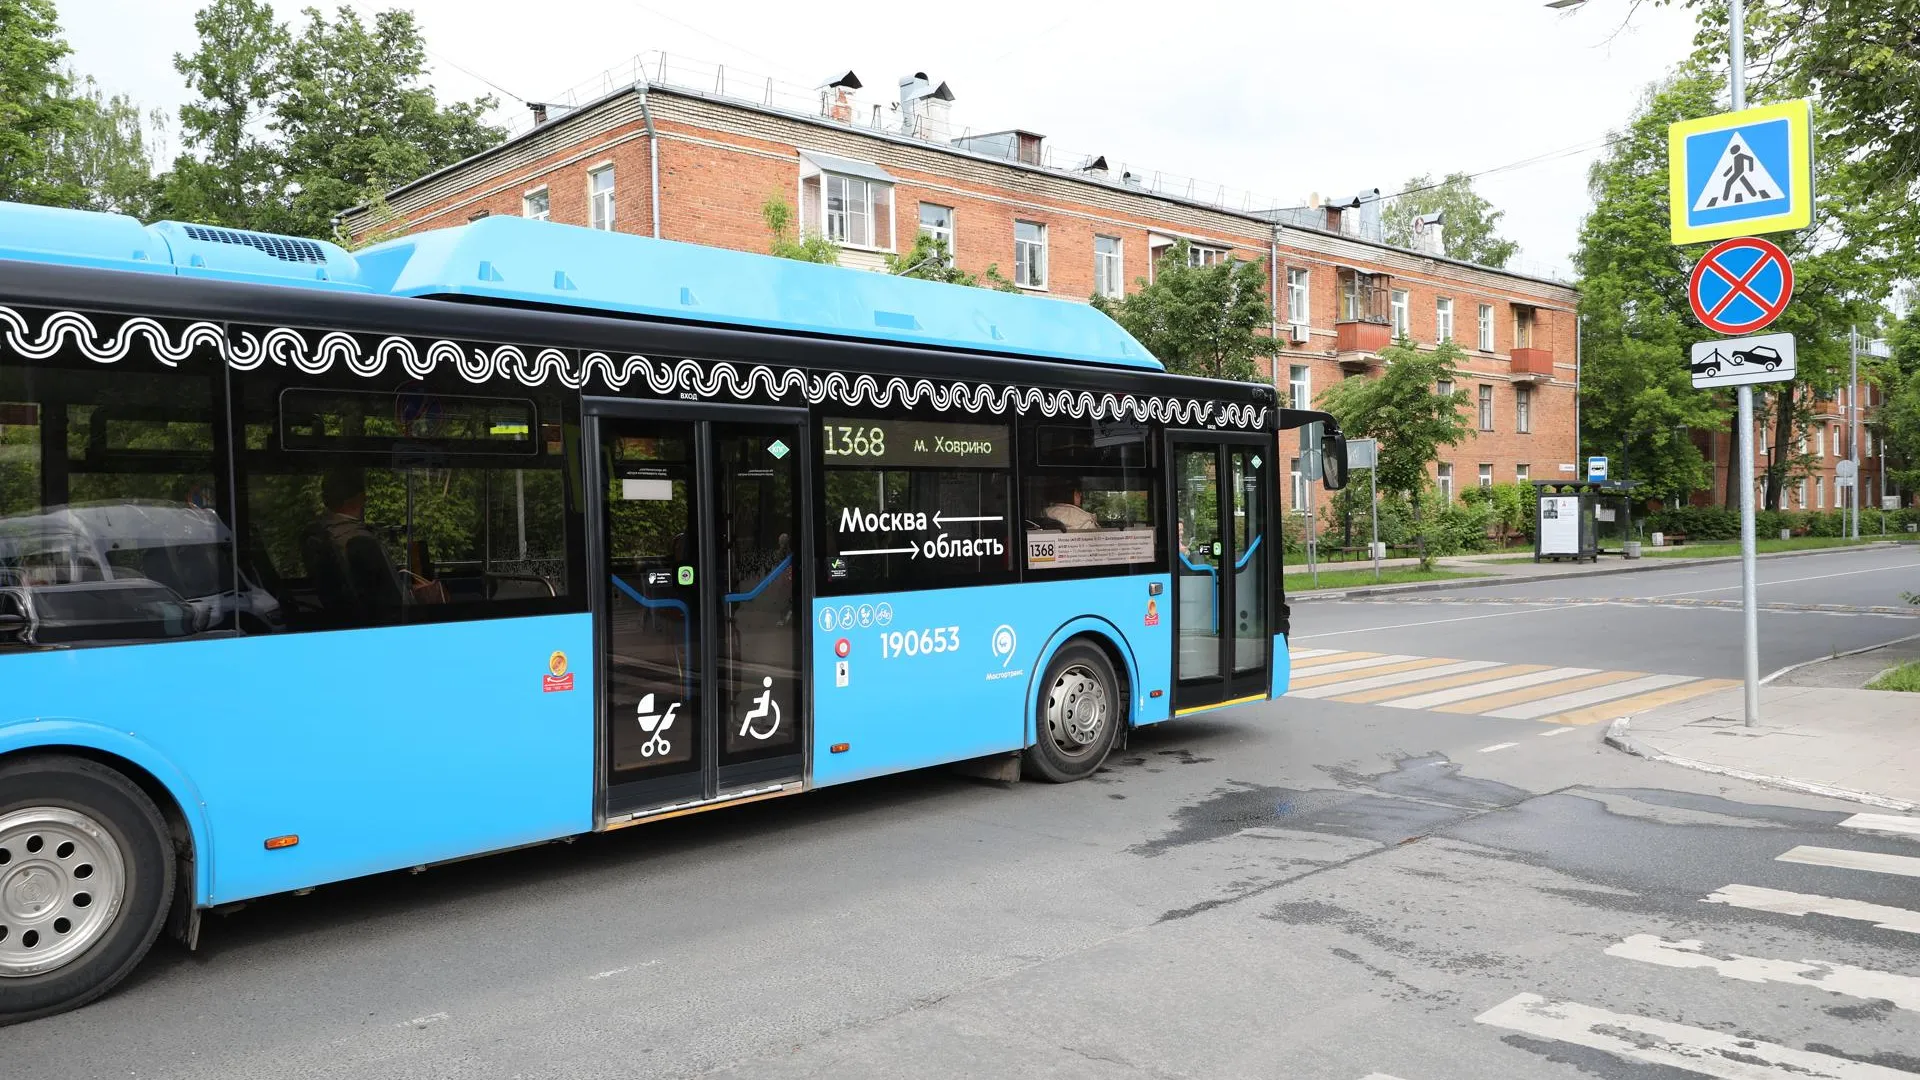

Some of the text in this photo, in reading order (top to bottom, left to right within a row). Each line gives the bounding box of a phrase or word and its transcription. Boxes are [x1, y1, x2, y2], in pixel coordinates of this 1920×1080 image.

[680, 392, 698, 401] ВХОД
[823, 425, 885, 457] 1368
[913, 435, 992, 456] м. Ховрино
[839, 507, 927, 533] Москва
[923, 533, 1004, 559] область
[1030, 543, 1055, 558] 1368
[880, 626, 960, 659] 190653
[986, 669, 1024, 681] Мосгортранс
